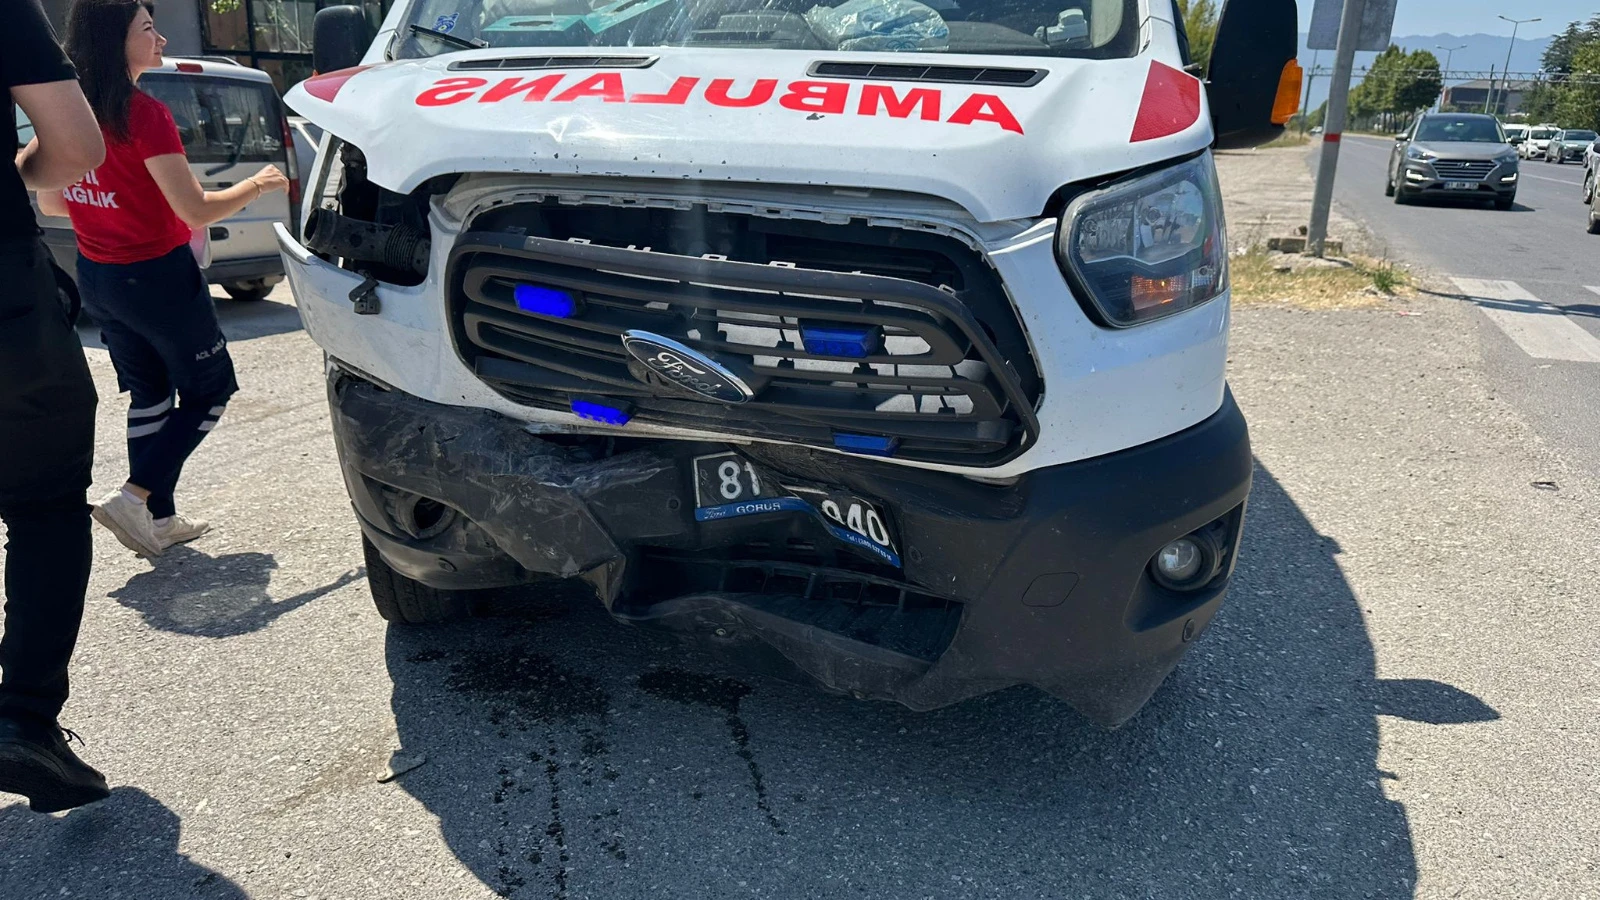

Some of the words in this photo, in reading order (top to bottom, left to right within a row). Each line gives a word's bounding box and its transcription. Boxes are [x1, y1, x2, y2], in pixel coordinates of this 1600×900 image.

[63, 183, 120, 209] AĞLIK
[647, 352, 722, 394] Ford
[718, 460, 761, 500] 81
